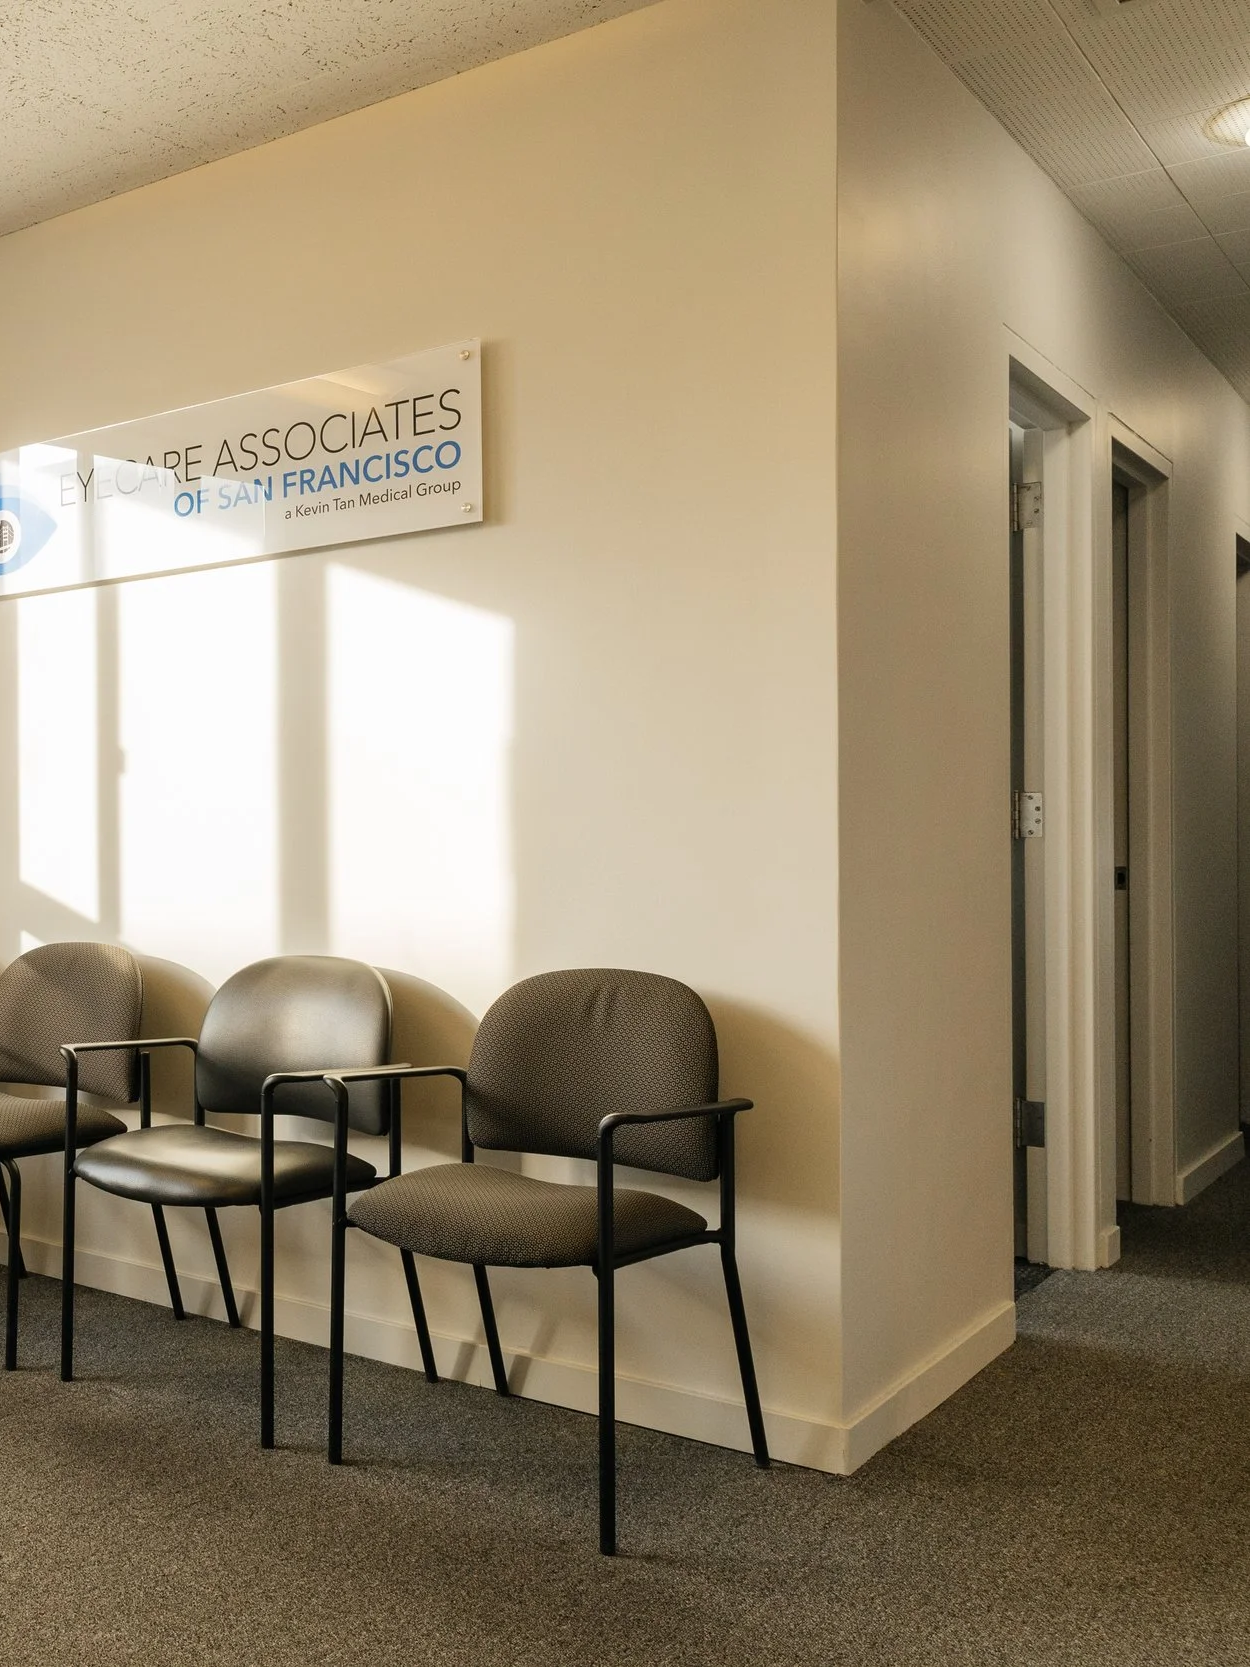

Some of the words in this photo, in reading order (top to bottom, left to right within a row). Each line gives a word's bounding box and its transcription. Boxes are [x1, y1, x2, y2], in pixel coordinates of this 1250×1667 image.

[212, 388, 462, 476] ASSOCIATES
[174, 488, 210, 517] OF
[217, 475, 273, 511] SAN
[283, 440, 462, 499] FRANCISCO
[284, 509, 293, 520] a
[295, 502, 330, 518] Kevin
[333, 497, 355, 512] Tan
[359, 486, 412, 506] Medical
[417, 479, 462, 498] Group
